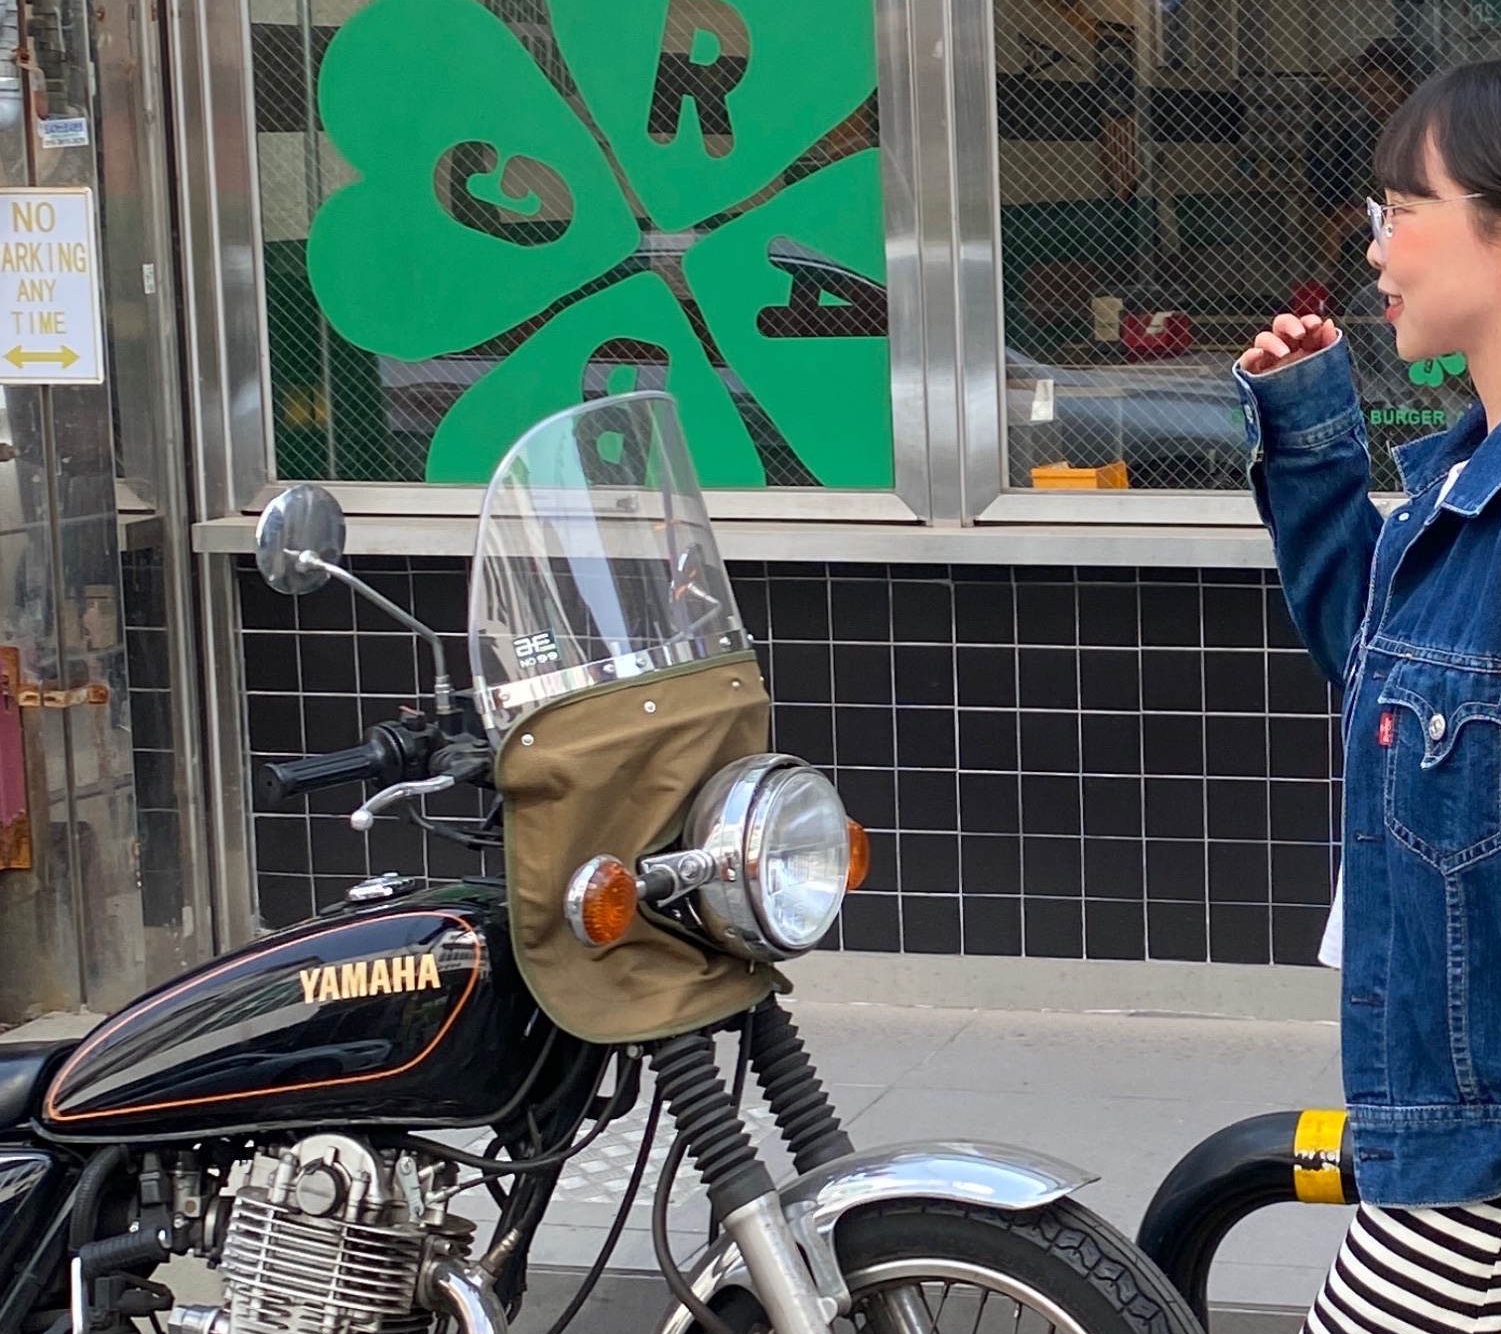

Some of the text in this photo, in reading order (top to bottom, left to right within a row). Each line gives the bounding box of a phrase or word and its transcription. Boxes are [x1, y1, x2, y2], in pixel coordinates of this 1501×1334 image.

[12, 201, 56, 232] NO
[0, 242, 86, 273] ARKING
[17, 279, 56, 302] ANY
[10, 311, 67, 334] TIME
[1370, 410, 1445, 425] BURGER
[299, 953, 442, 1005] YAMAHA
